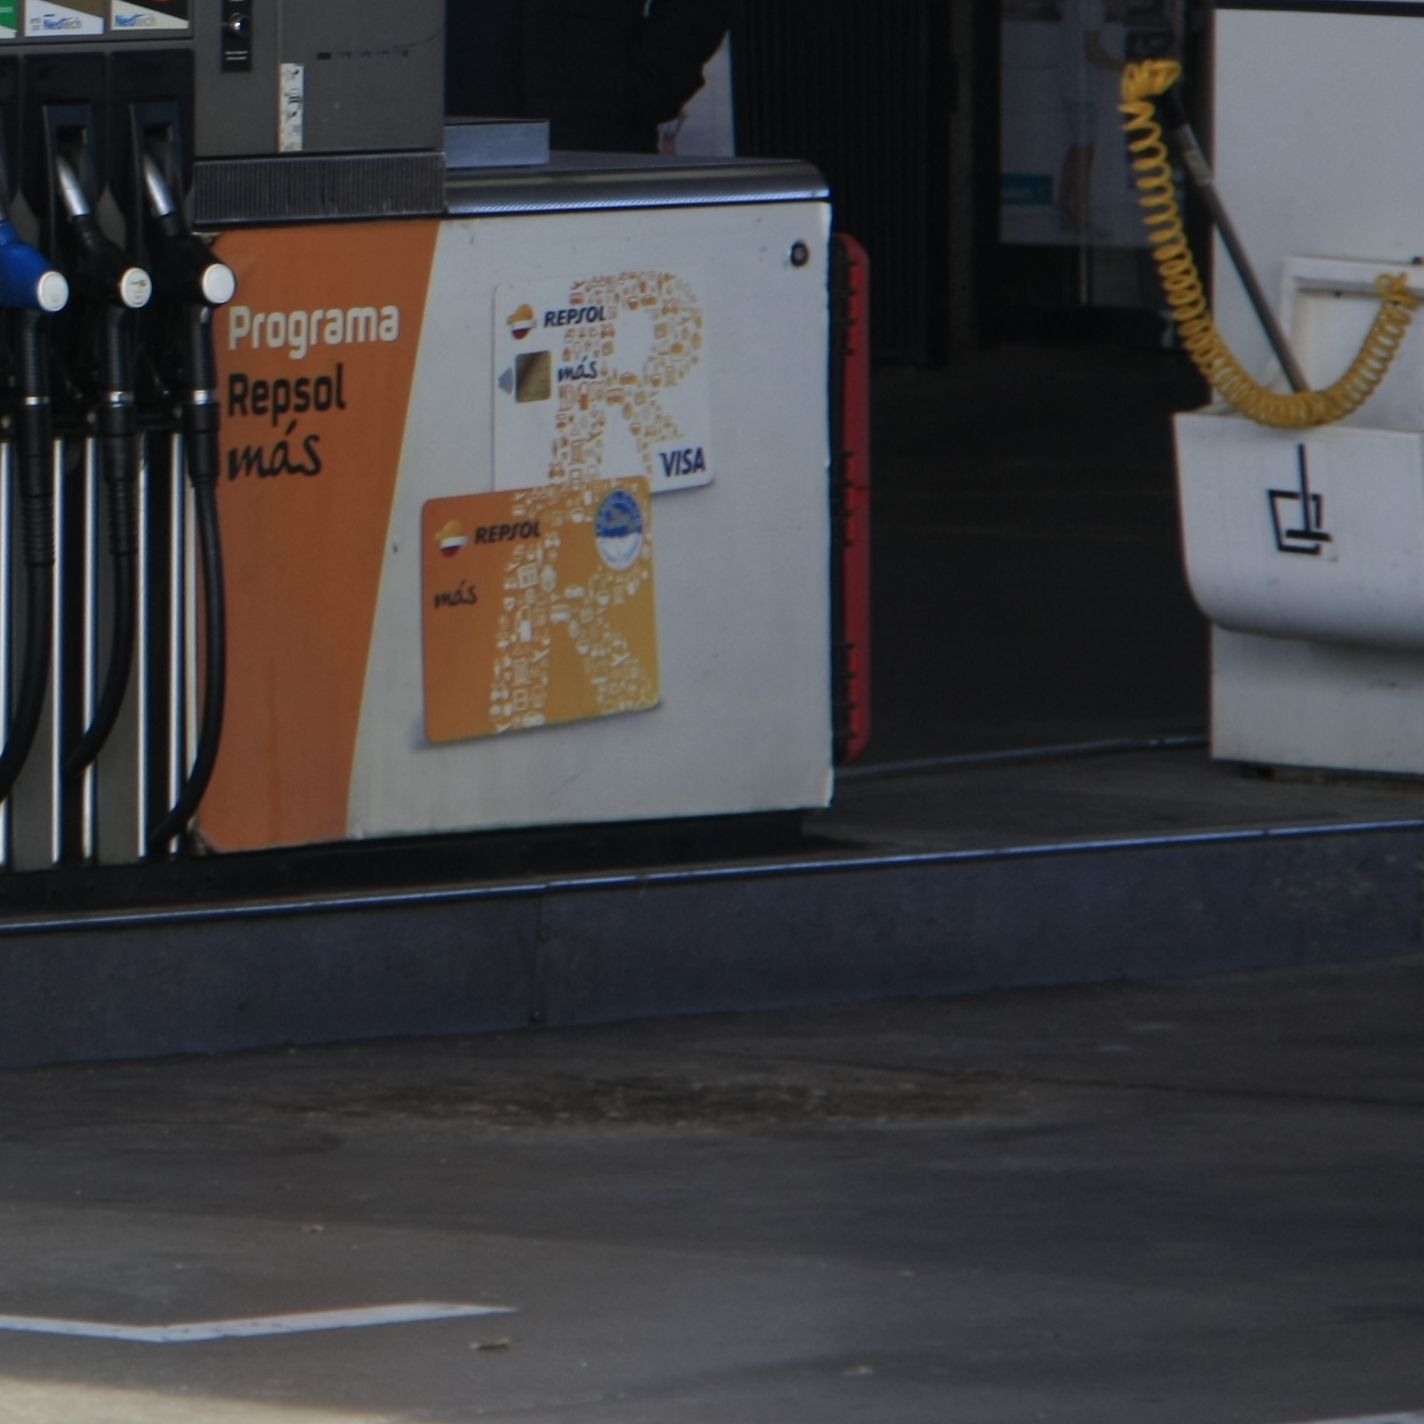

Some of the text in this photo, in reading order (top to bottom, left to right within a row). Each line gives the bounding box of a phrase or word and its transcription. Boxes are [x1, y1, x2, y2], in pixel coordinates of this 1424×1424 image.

[543, 305, 605, 328] REPSOL
[227, 305, 400, 360] Programa
[557, 356, 598, 382] más
[228, 363, 347, 428] Repsol
[227, 419, 322, 481] más
[657, 447, 706, 478] VISA
[474, 522, 541, 545] REPSOL
[433, 581, 478, 609] más
